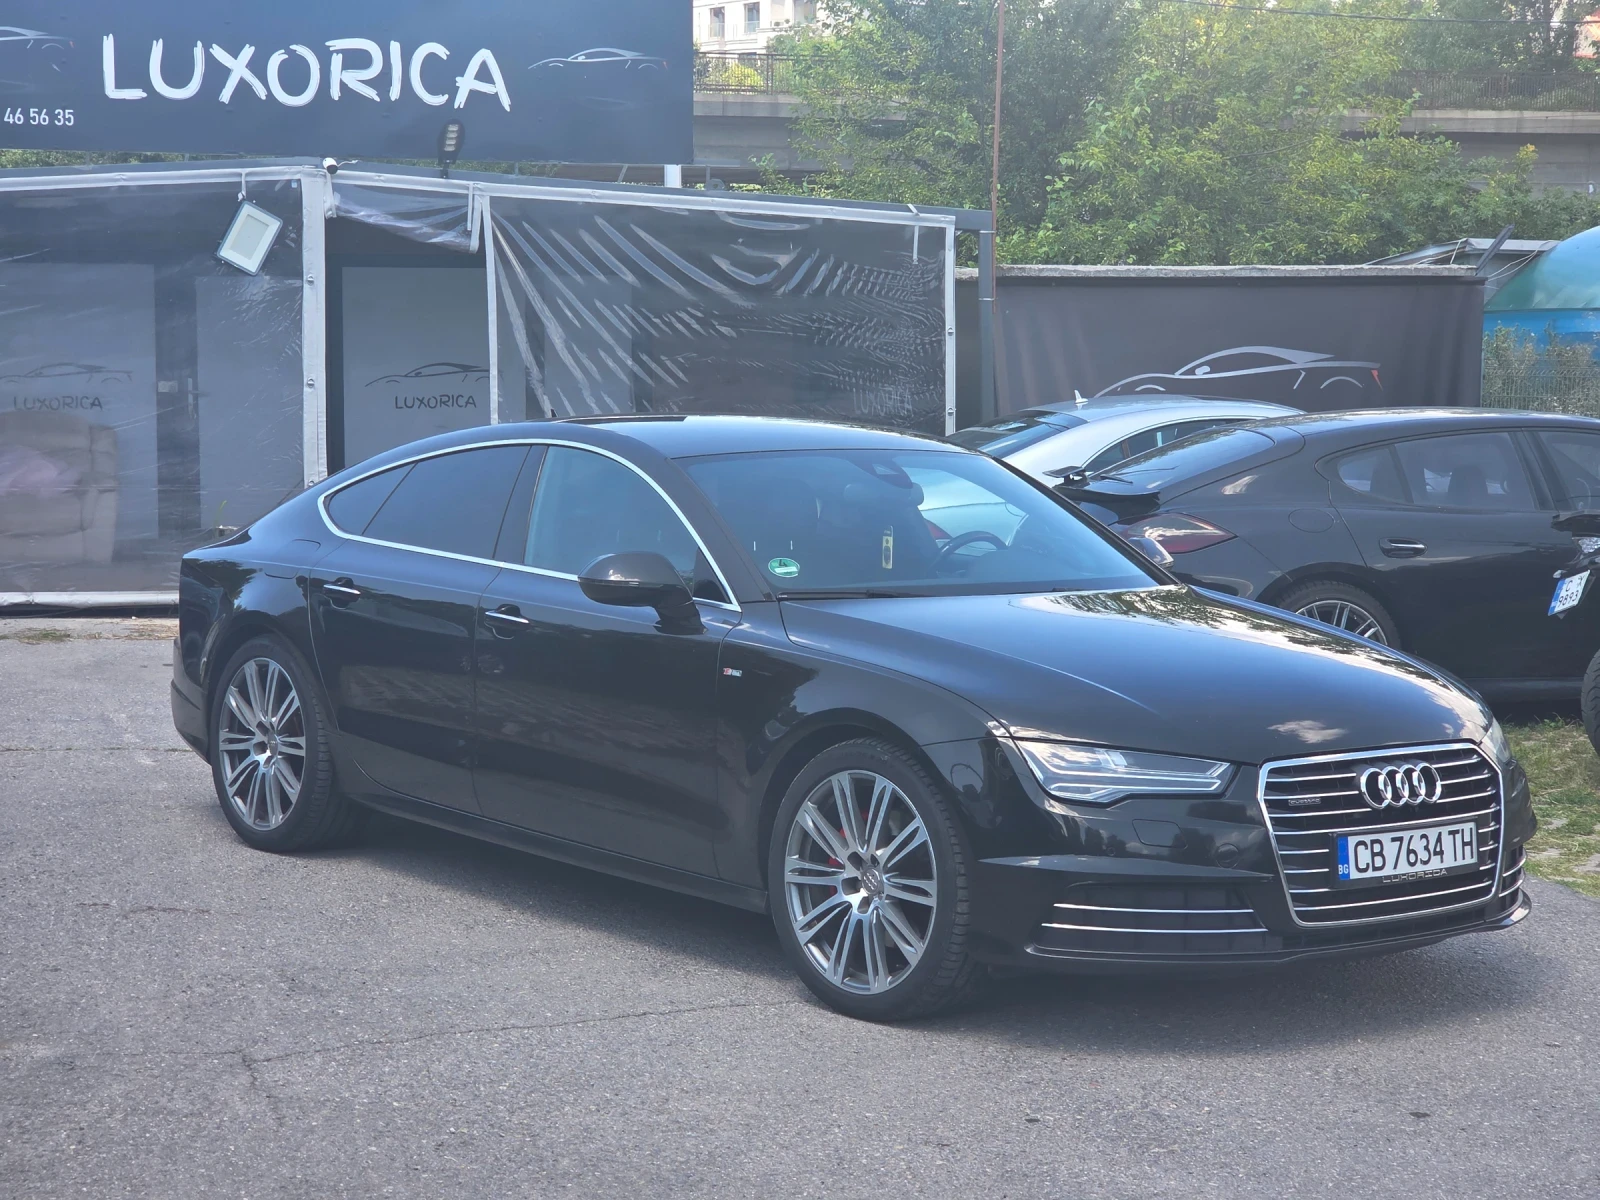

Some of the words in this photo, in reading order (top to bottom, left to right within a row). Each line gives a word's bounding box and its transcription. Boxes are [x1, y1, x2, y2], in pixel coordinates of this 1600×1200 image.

[103, 34, 511, 112] LUXORICA
[3, 108, 24, 125] 46
[29, 108, 49, 126] 56
[54, 109, 75, 126] 35
[13, 395, 103, 411] LUXORICA
[395, 394, 477, 409] LUXORICA
[1353, 838, 1387, 874] CB
[1390, 831, 1445, 871] 7634
[1448, 827, 1474, 862] TH
[1338, 864, 1349, 875] BG
[1382, 868, 1447, 883] LUXORICA
